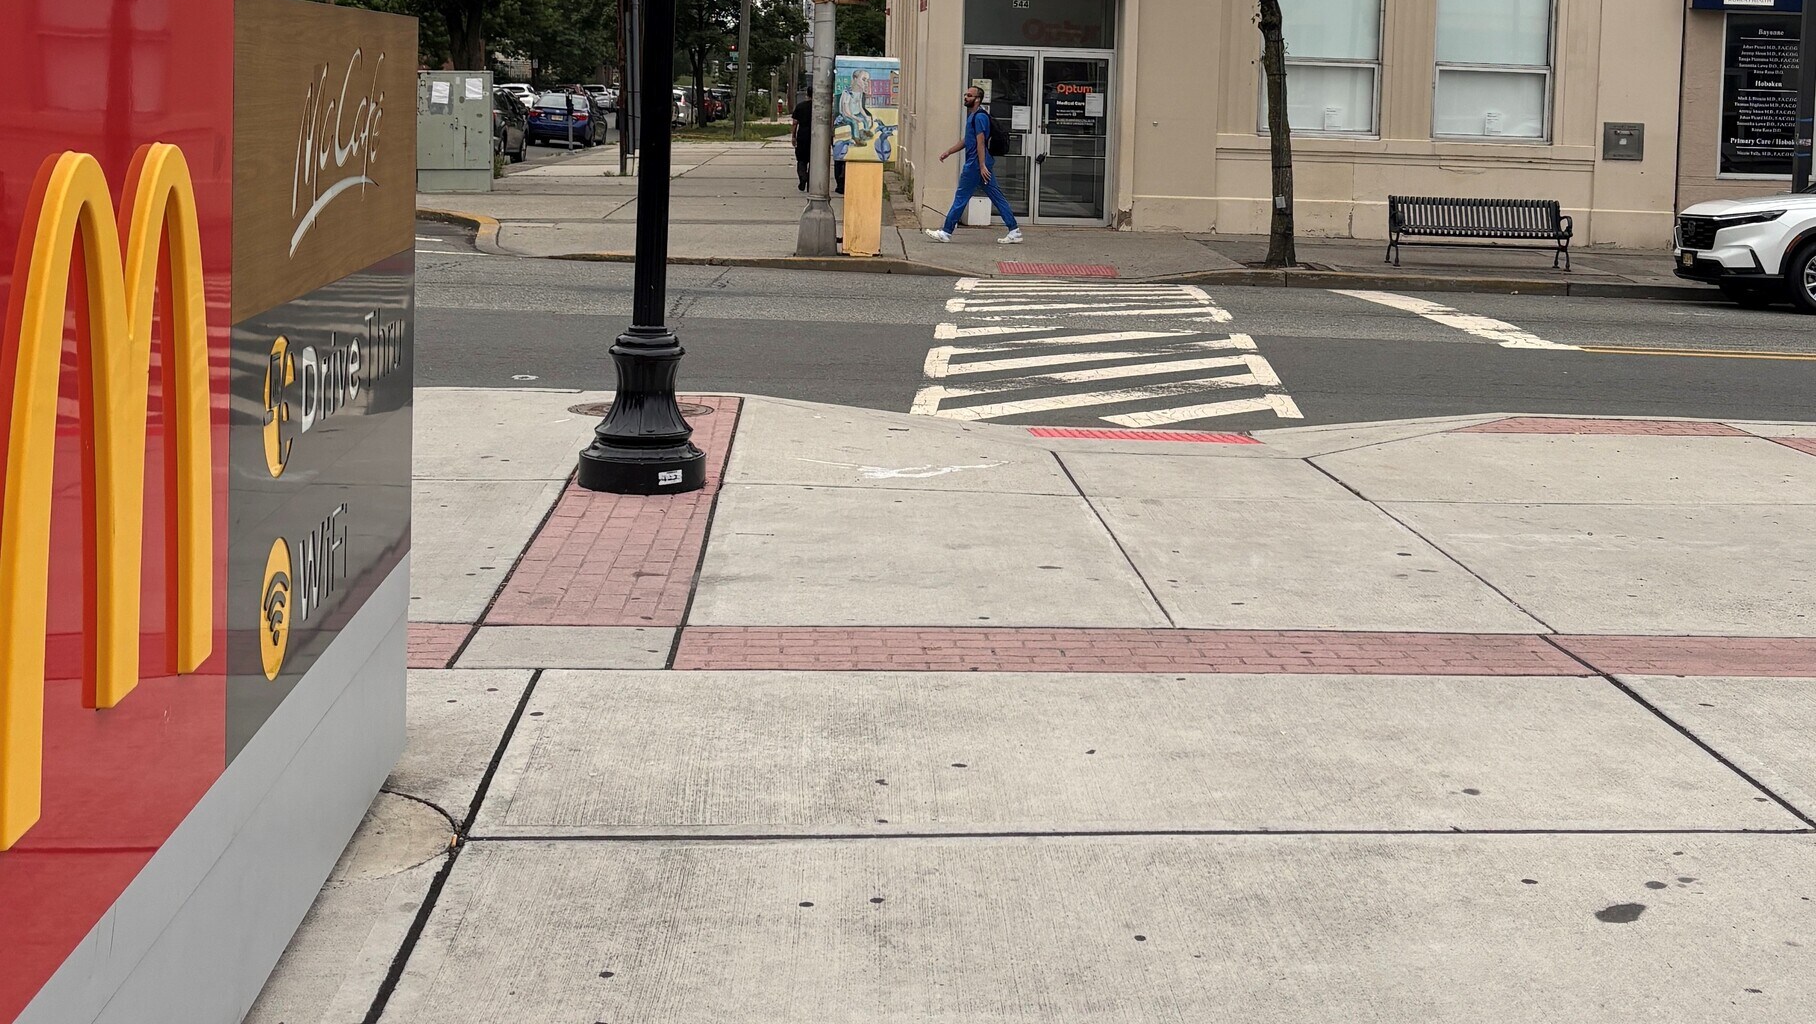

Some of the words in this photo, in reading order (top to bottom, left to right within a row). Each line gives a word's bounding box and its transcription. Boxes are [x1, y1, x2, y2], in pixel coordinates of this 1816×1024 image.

[1013, 0, 1029, 8] 544
[1758, 28, 1785, 36] Bayonne
[1056, 83, 1093, 95] Optum
[292, 47, 386, 229] McCafé
[302, 332, 361, 434] Drive
[365, 307, 402, 388] Thru
[299, 503, 347, 621] WiFi
